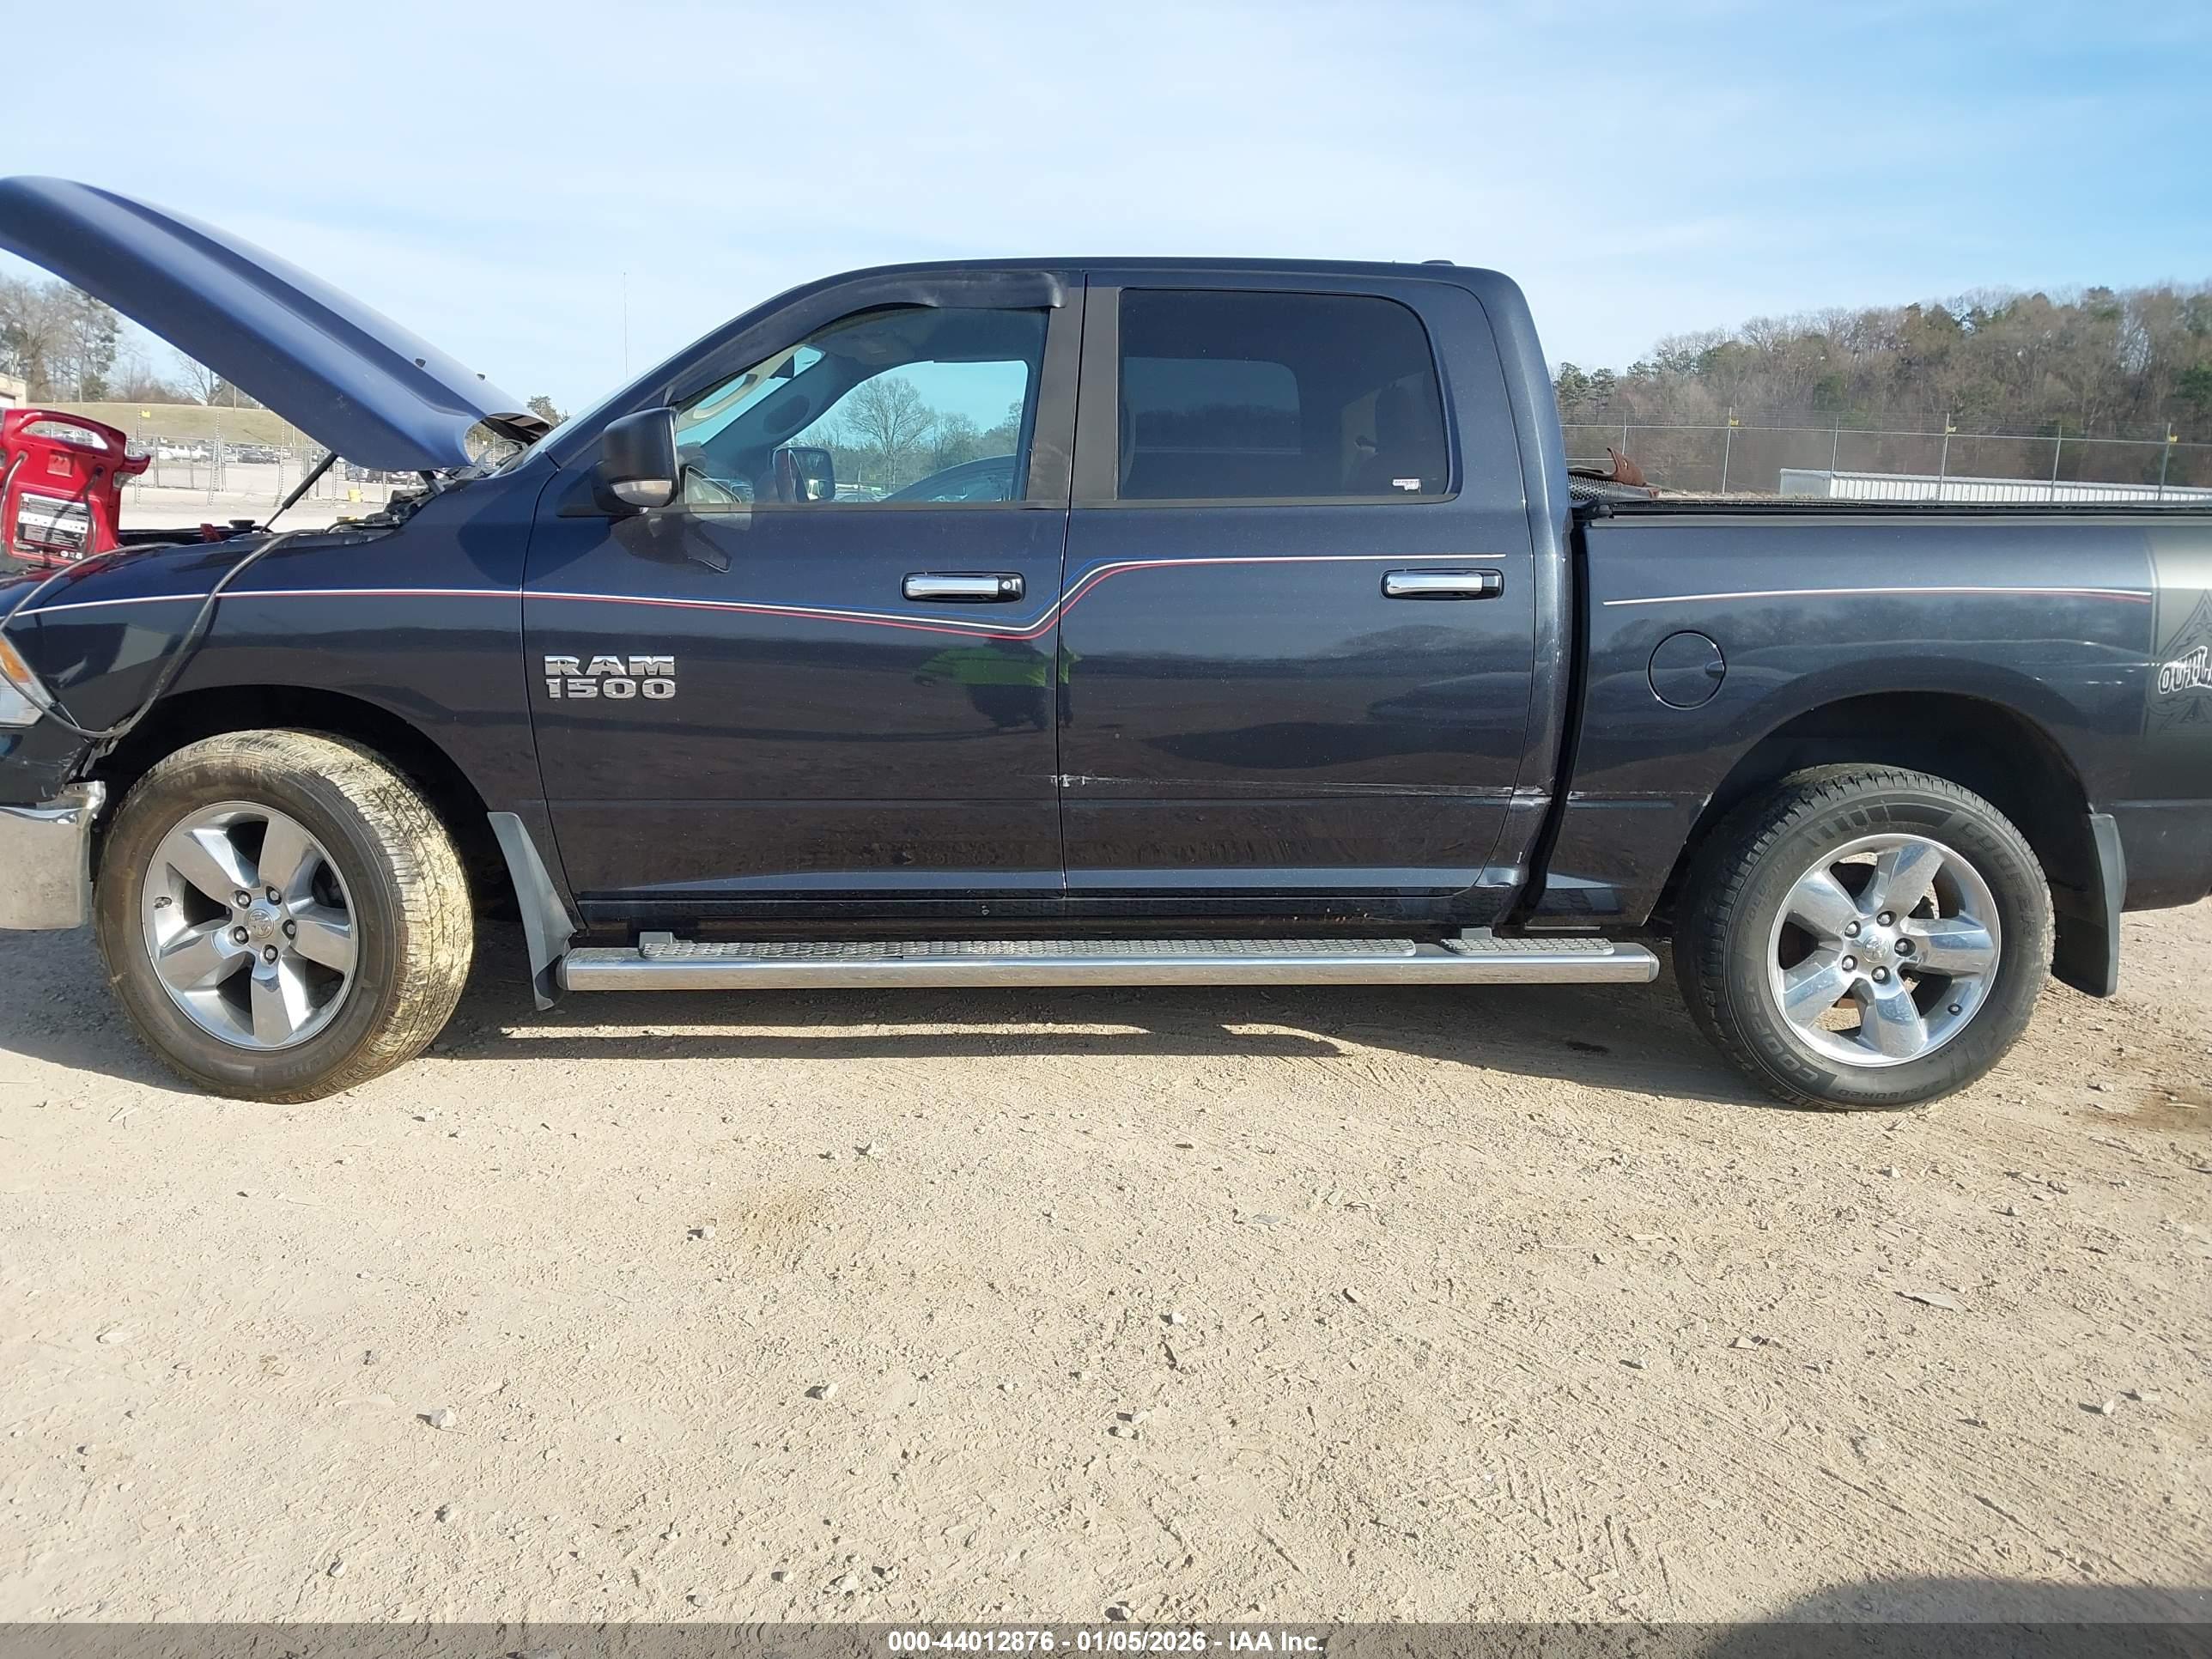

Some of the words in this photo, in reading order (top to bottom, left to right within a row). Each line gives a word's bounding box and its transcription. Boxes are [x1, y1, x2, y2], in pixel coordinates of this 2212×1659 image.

[544, 655, 675, 676] RAM
[2158, 646, 2212, 694] OUTL
[545, 678, 676, 700] 1500
[1838, 1080, 1942, 1100] 75/60R20
